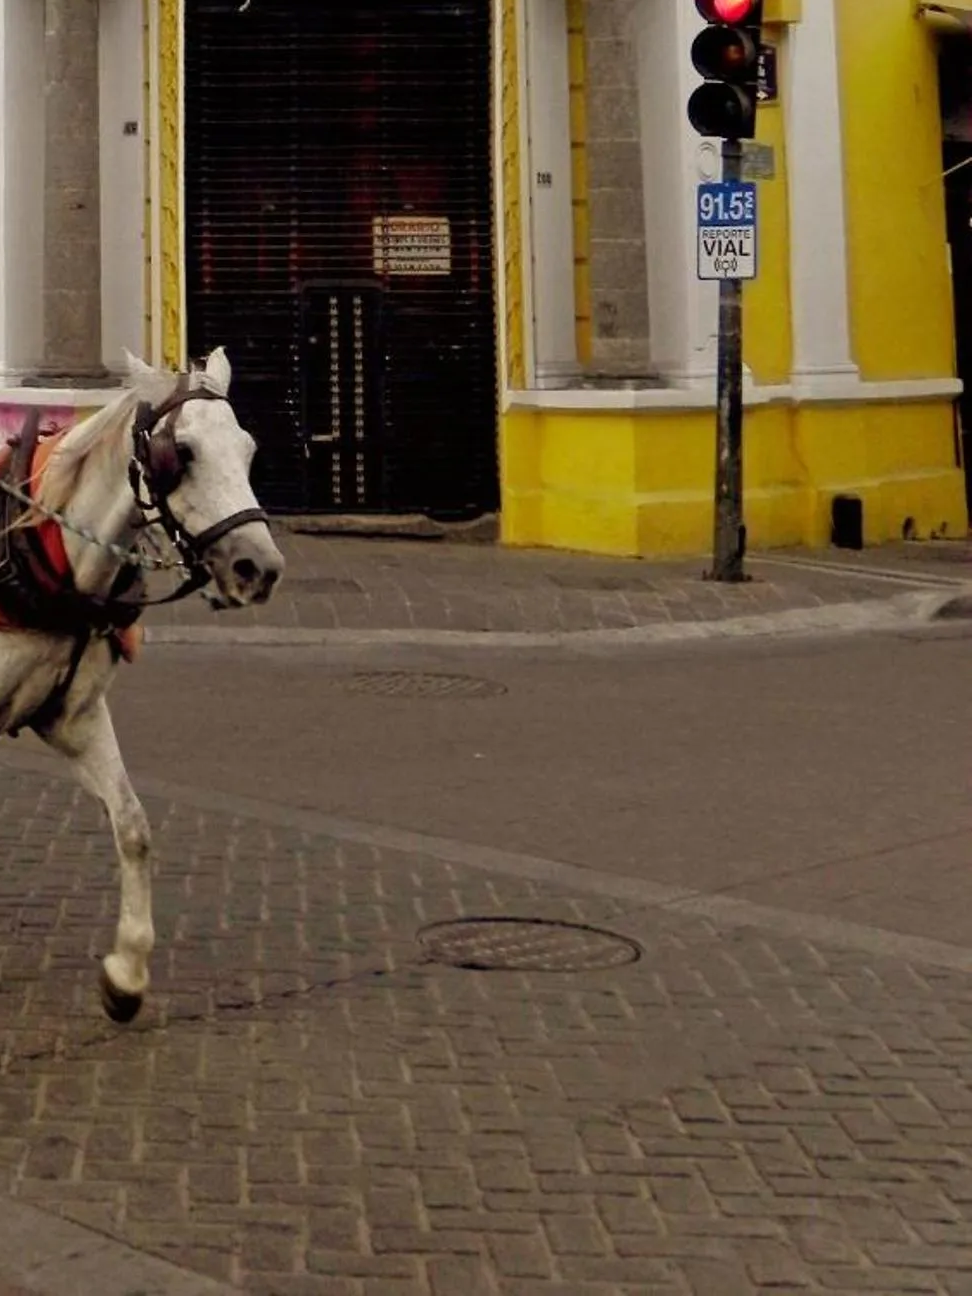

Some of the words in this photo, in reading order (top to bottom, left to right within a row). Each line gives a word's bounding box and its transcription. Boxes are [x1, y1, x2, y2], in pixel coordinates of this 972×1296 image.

[699, 191, 744, 221] 91.5
[744, 191, 754, 219] FM
[702, 229, 751, 239] REPORTE
[703, 239, 751, 257] VIAL
